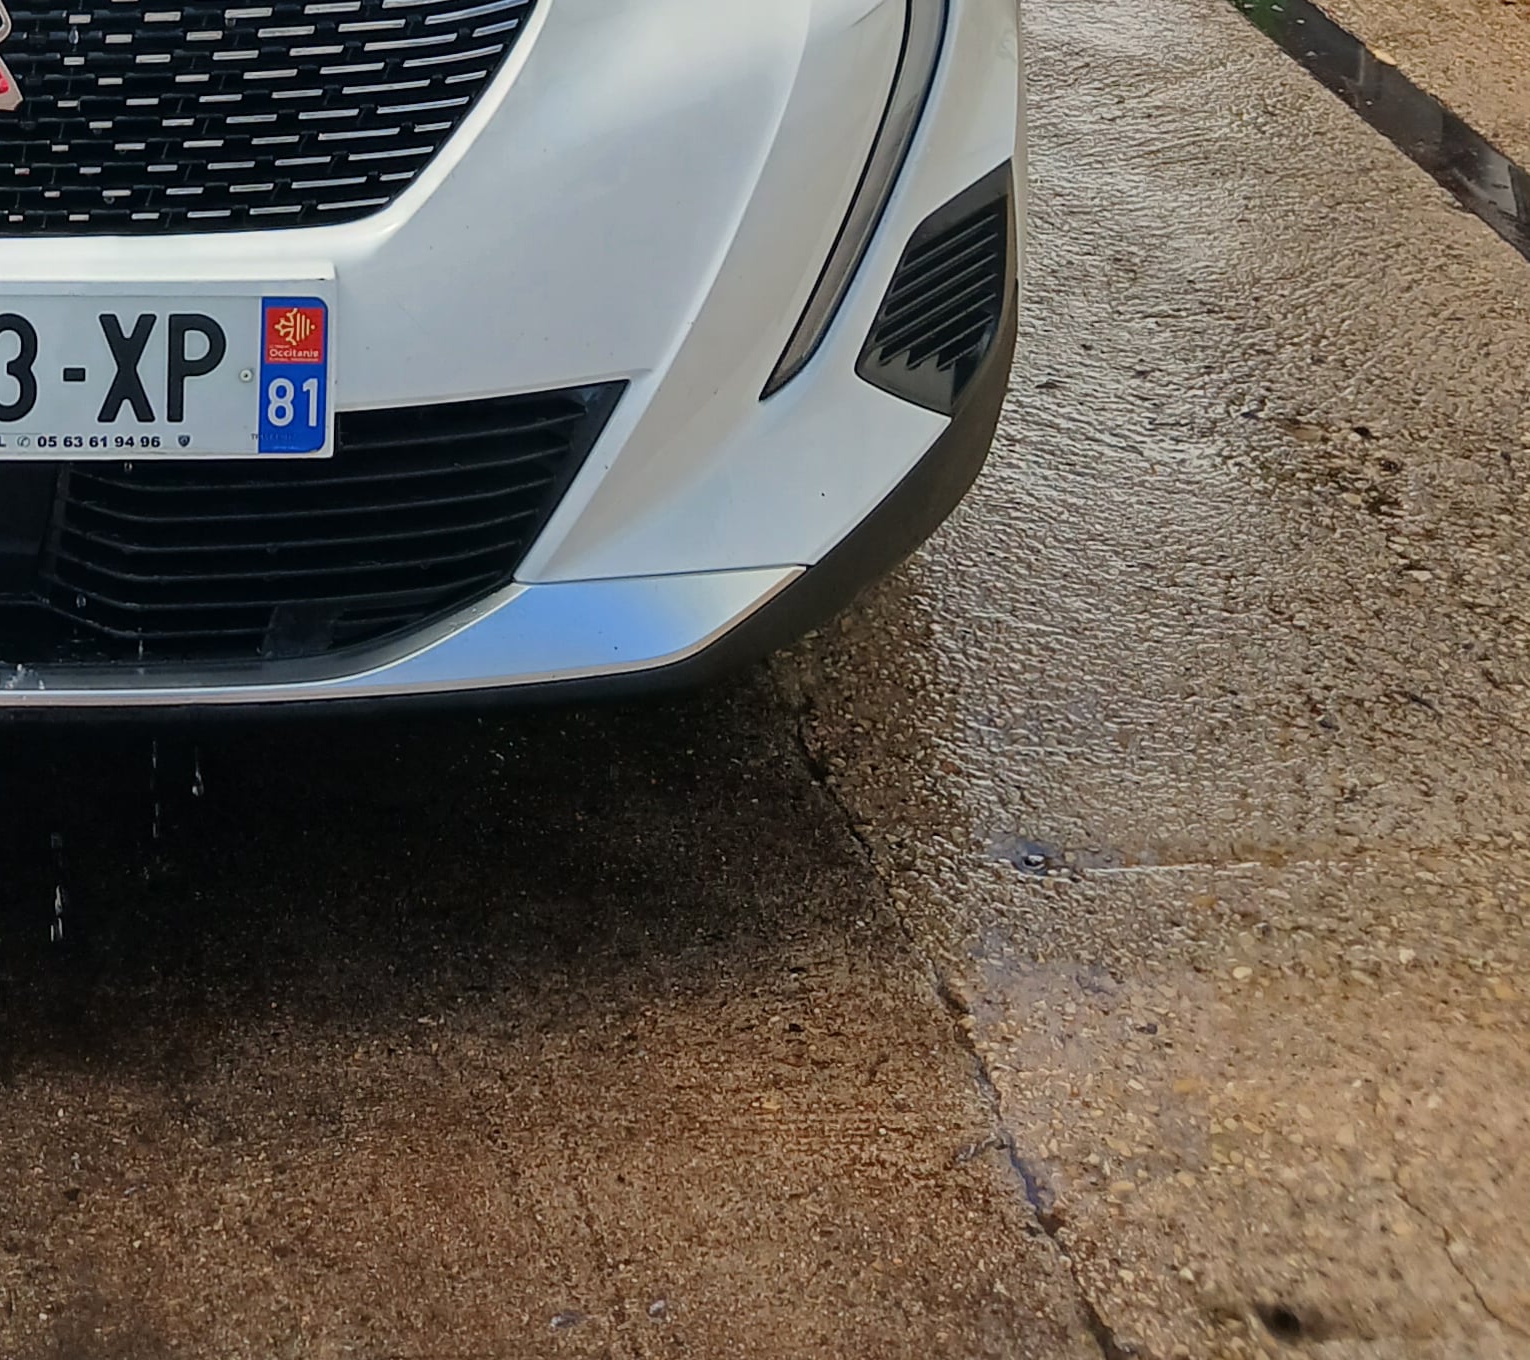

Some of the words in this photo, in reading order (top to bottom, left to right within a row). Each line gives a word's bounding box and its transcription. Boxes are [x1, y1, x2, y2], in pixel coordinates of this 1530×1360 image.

[270, 347, 319, 358] Occitanie
[267, 377, 319, 427] 81
[37, 436, 57, 448] 05
[63, 436, 83, 448] 63
[89, 436, 108, 448] 61
[114, 436, 134, 448] 94
[140, 436, 161, 448] 96
